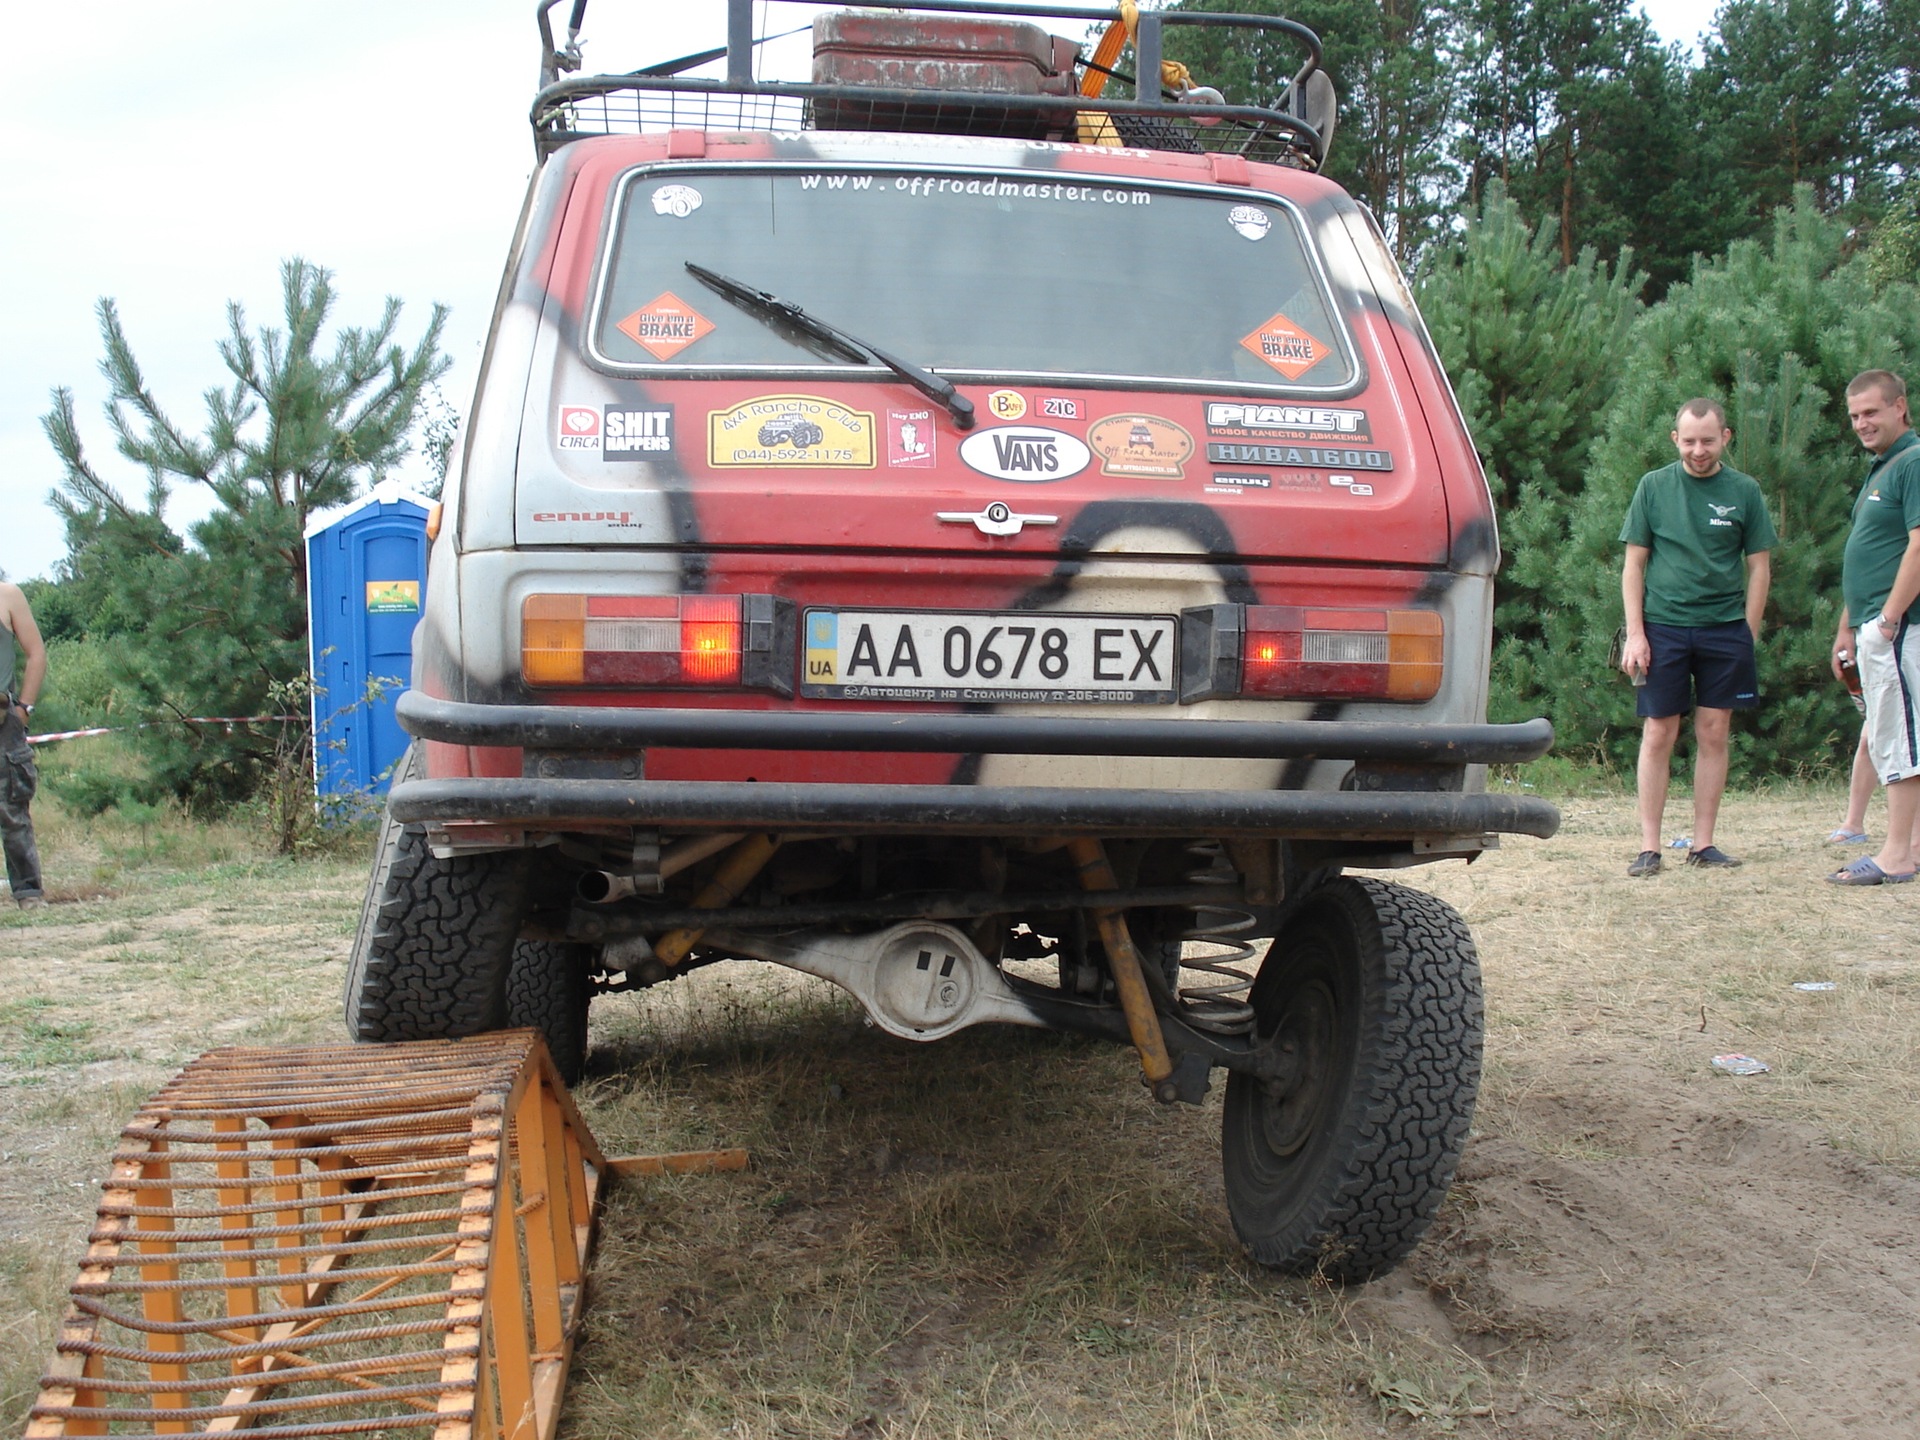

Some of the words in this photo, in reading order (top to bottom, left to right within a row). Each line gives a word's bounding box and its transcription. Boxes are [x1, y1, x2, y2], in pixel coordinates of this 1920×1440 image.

[640, 313, 664, 323] Give
[639, 323, 695, 338] BRAKE
[1260, 333, 1284, 343] Give
[1304, 338, 1312, 346] a
[1262, 342, 1314, 360] BRAKE
[1044, 399, 1075, 416] ZIC
[606, 412, 671, 436] SHIT
[722, 410, 748, 431] 4x4
[751, 401, 821, 416] Rancho
[826, 406, 862, 433] Club
[1208, 403, 1364, 431] PLANET
[560, 437, 599, 448] CIRCA
[1211, 428, 1249, 437] НОВОЕ
[1251, 430, 1306, 439] КАЧЕСТВО
[1309, 433, 1369, 442] ДВИЖЕНИЯ
[605, 436, 670, 451] HAPPENS
[733, 449, 853, 461] (044)-592-1175
[992, 434, 1059, 472] VANS
[1104, 446, 1120, 458] Off
[1123, 448, 1146, 458] Road
[1149, 449, 1180, 458] Master
[1216, 445, 1305, 463] НИВА
[1308, 449, 1383, 467] 1600
[533, 512, 629, 524] envy
[847, 623, 922, 677] AA
[943, 625, 1069, 680] 0678
[1093, 628, 1164, 682] EX
[810, 661, 833, 676] UA
[860, 686, 935, 699] Автоцентр
[940, 689, 957, 697] на
[963, 689, 1048, 701] Столичному
[1067, 690, 1134, 701] 206-8000
